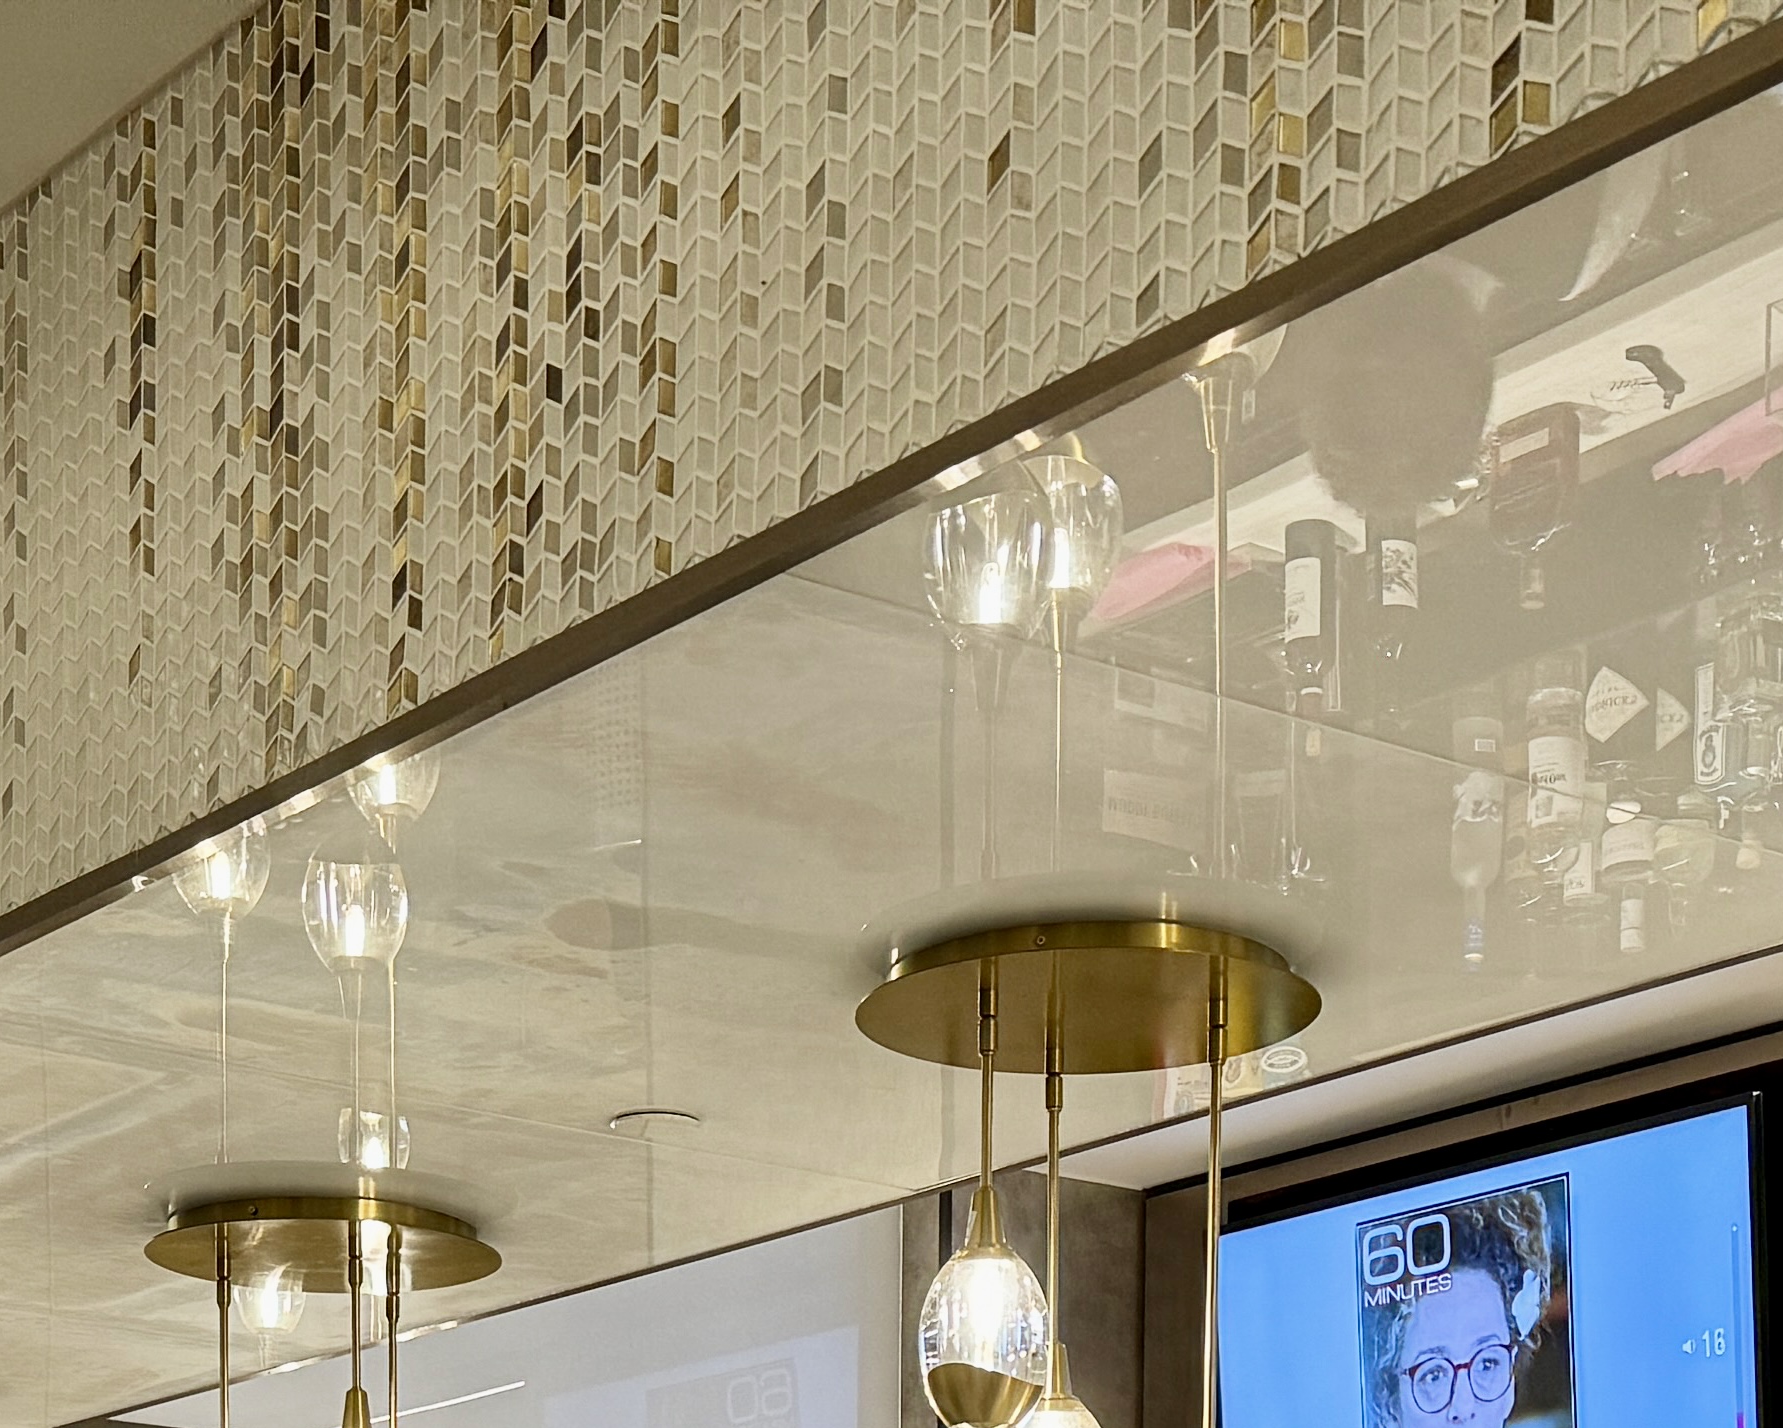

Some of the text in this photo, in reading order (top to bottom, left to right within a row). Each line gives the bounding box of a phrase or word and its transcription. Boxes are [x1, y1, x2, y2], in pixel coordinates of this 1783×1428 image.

[1363, 1213, 1451, 1286] 60
[1364, 1273, 1452, 1307] MINUTES
[1702, 1328, 1725, 1357] 16
